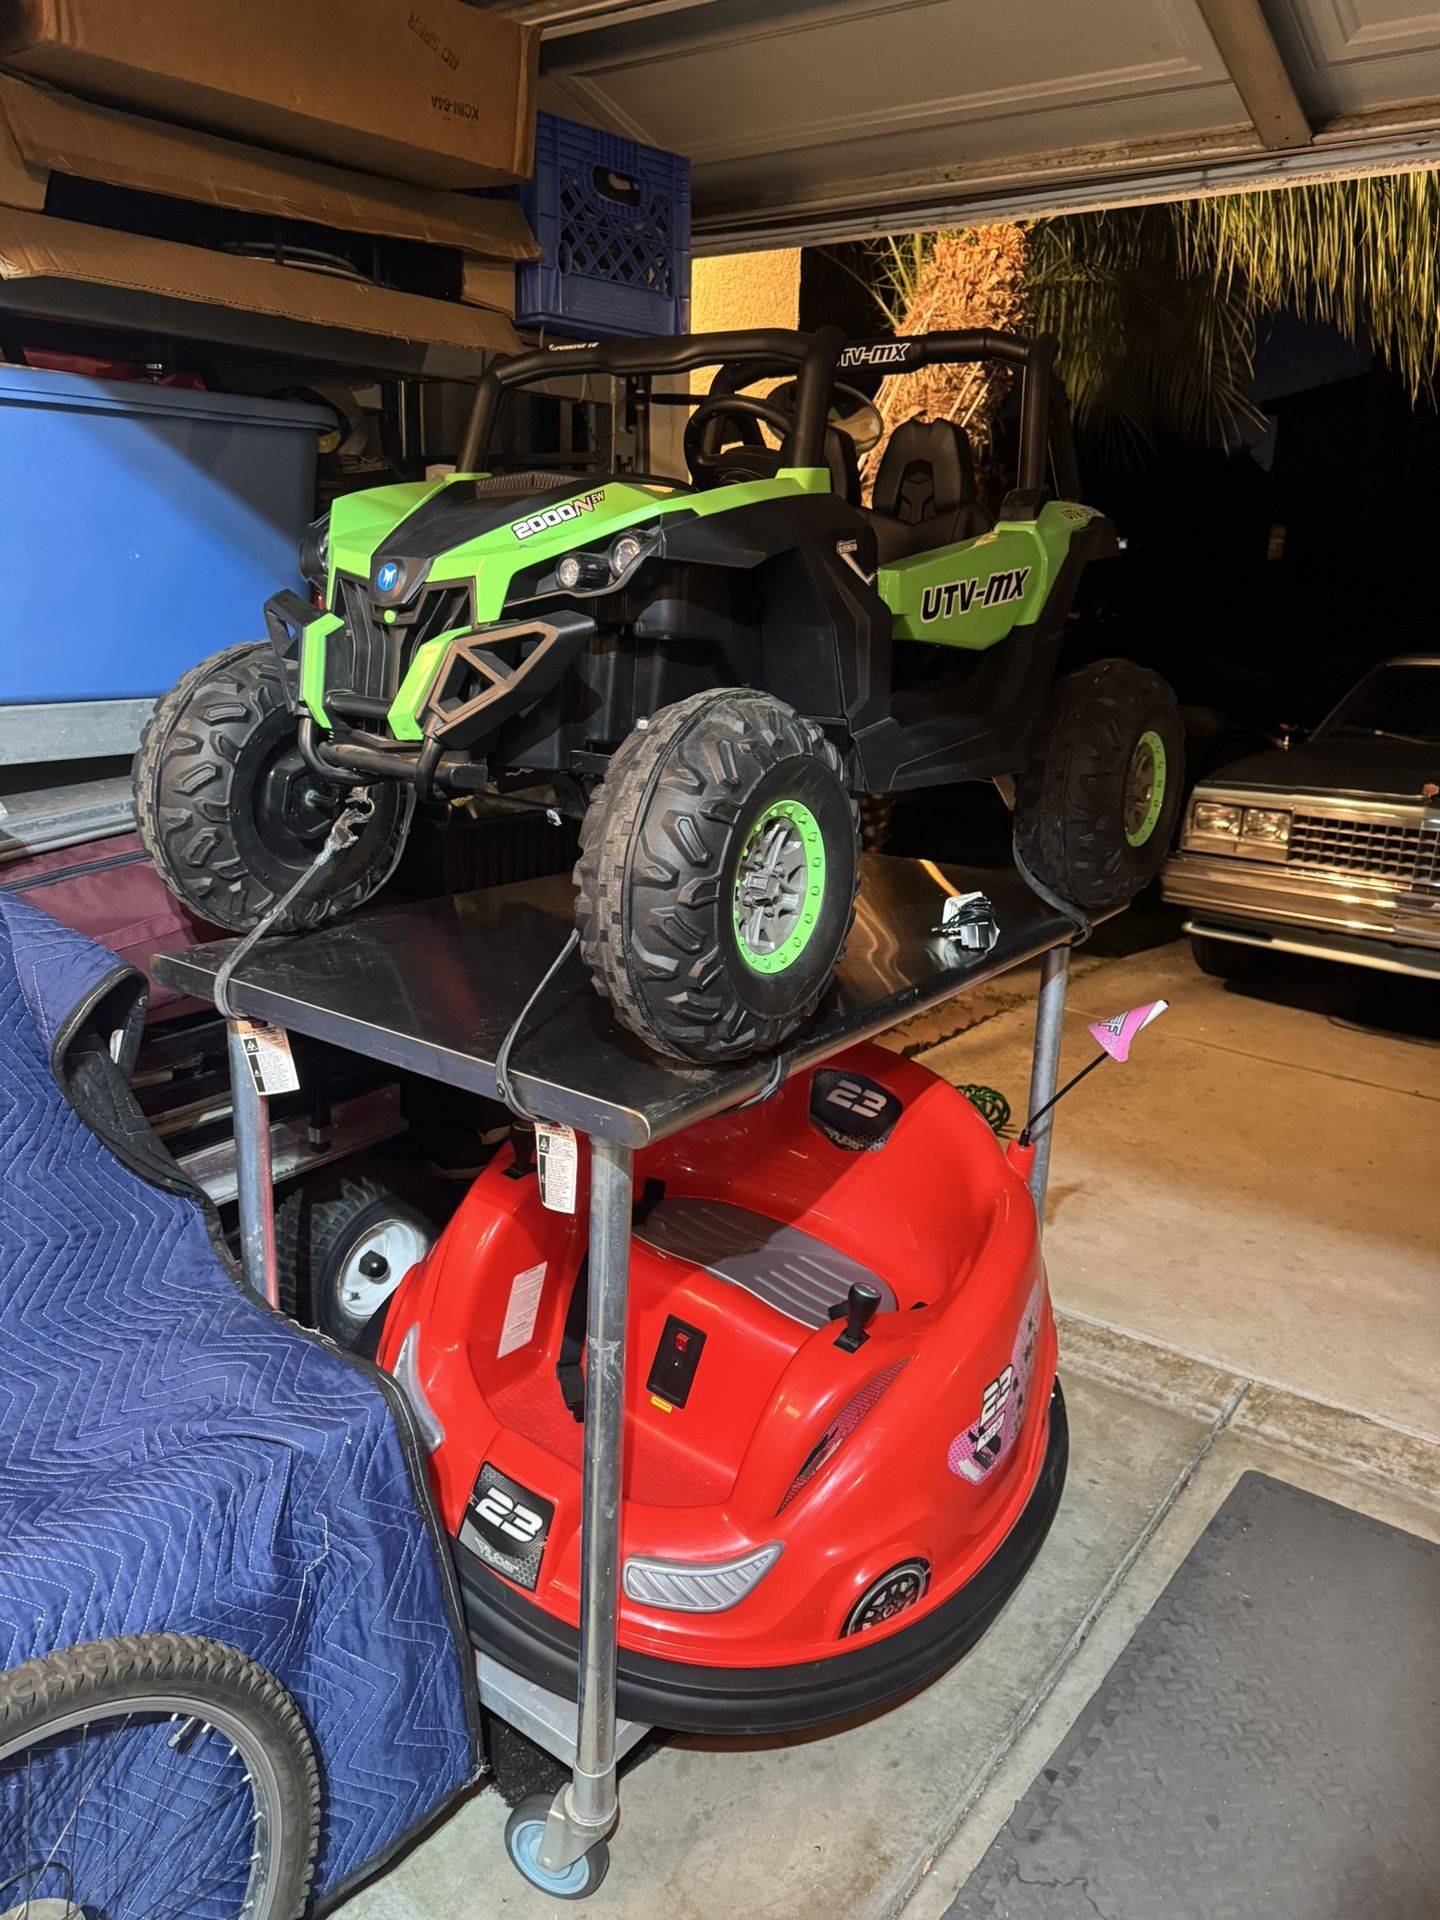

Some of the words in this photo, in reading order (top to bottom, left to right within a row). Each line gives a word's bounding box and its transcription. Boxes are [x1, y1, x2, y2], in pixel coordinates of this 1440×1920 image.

[836, 342, 912, 368] TV-MX
[826, 1079, 888, 1118] 23
[980, 1363, 1014, 1430] 23
[474, 1484, 544, 1543] 23
